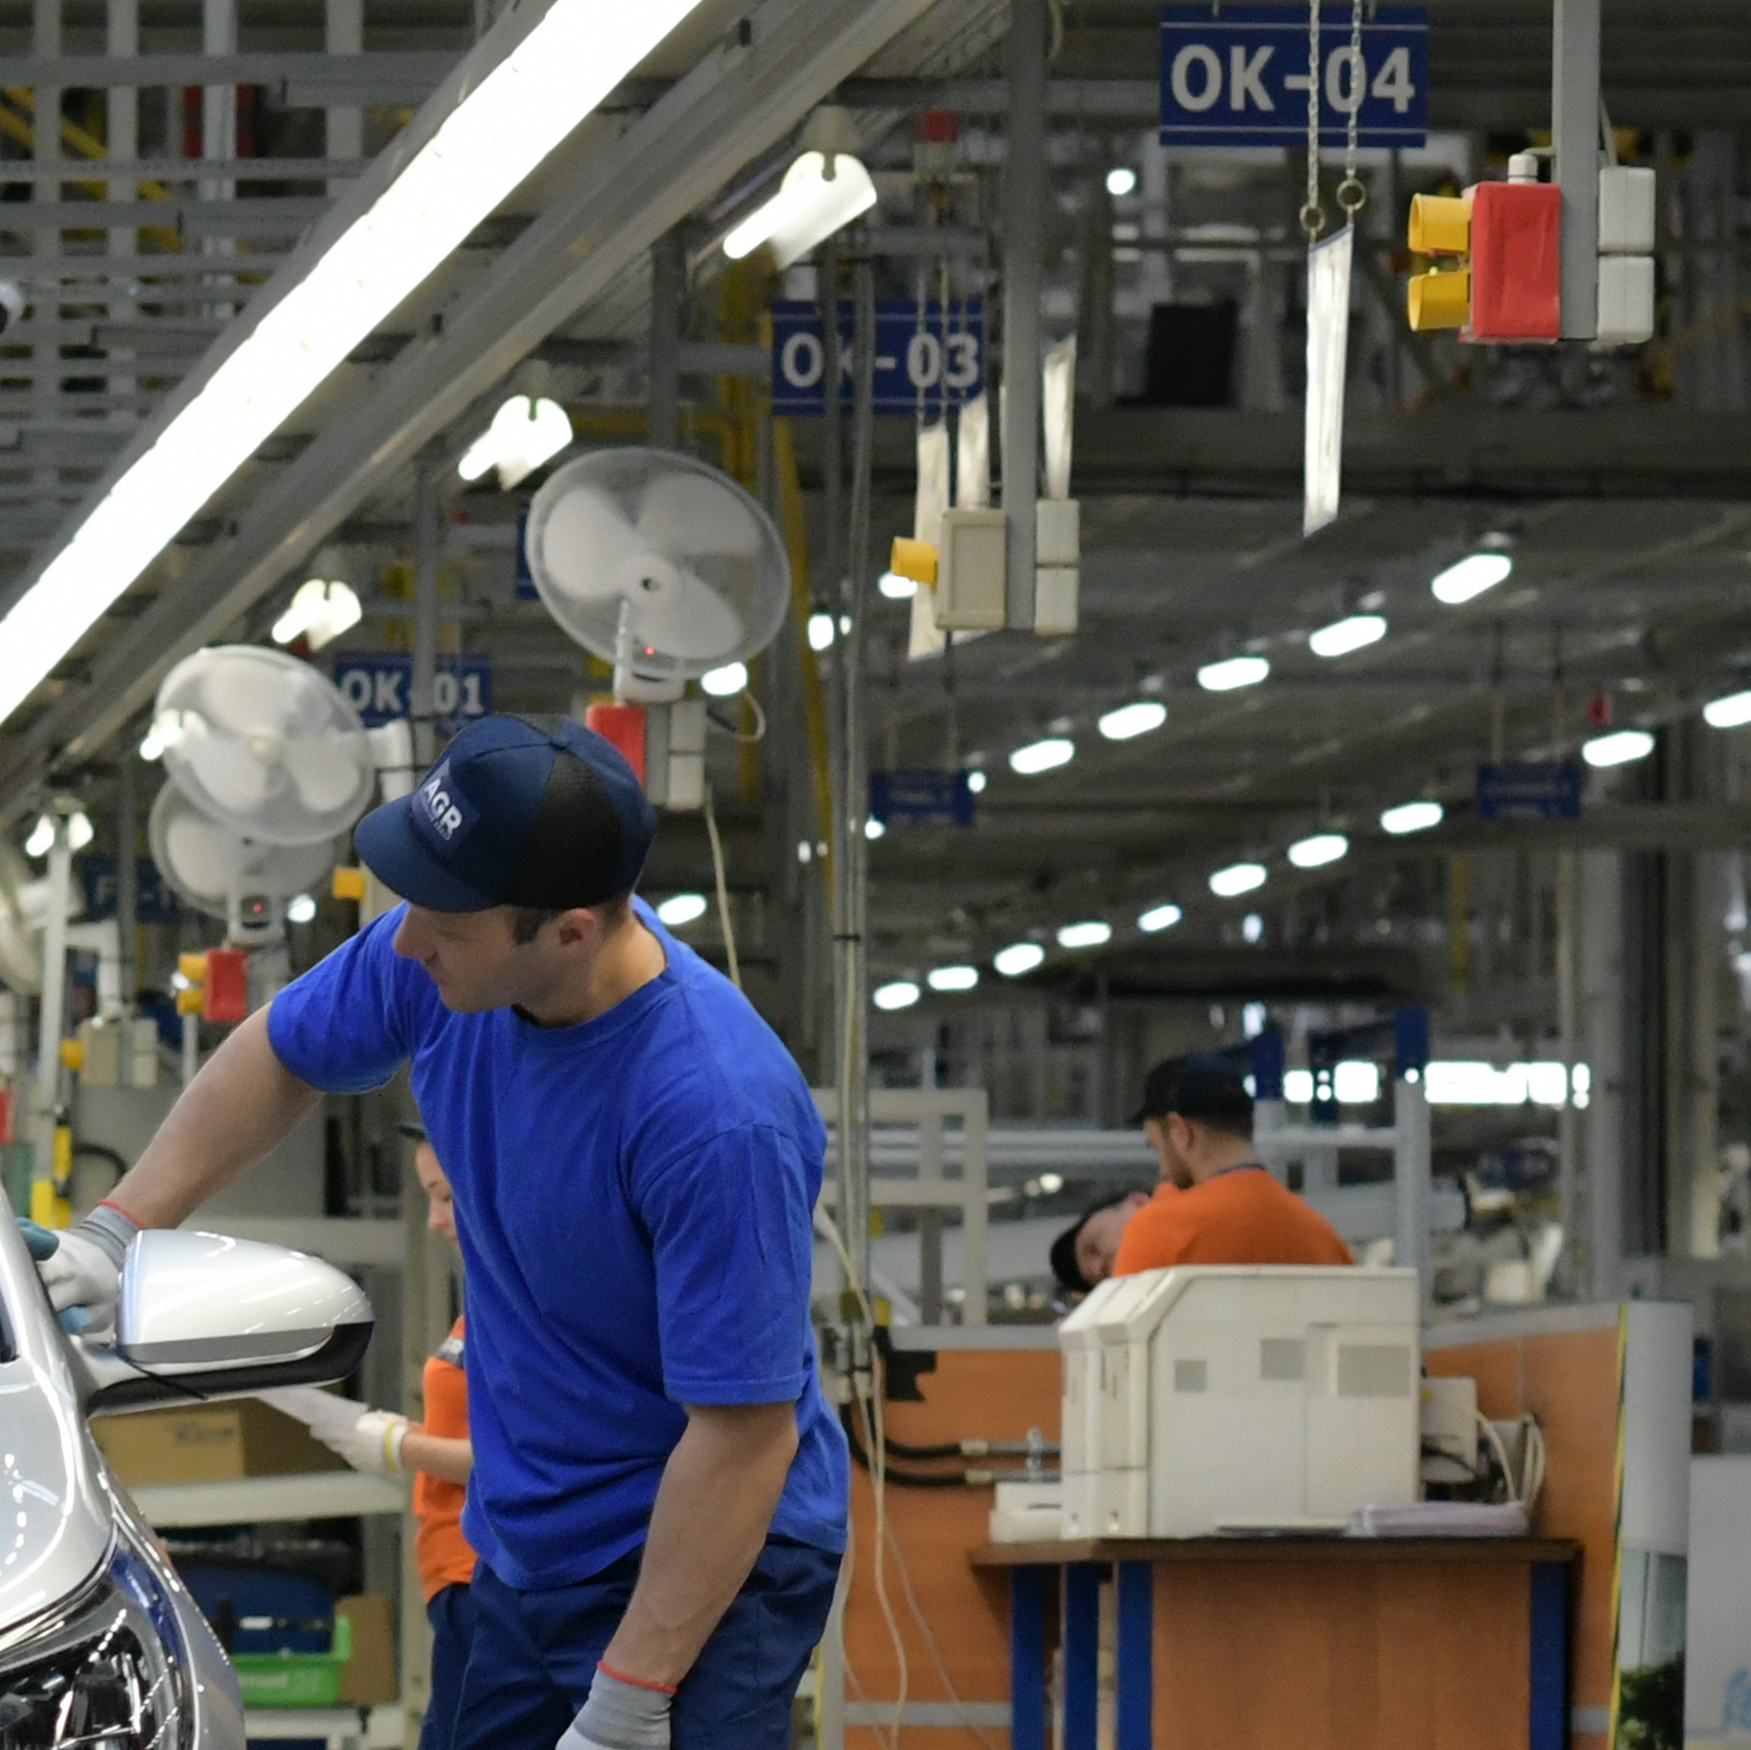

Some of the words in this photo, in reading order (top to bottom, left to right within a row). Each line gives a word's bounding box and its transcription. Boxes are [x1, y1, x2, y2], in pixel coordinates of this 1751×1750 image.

[1171, 44, 1415, 113] OK-04
[341, 669, 484, 714] OK01
[423, 778, 462, 838] AGR
